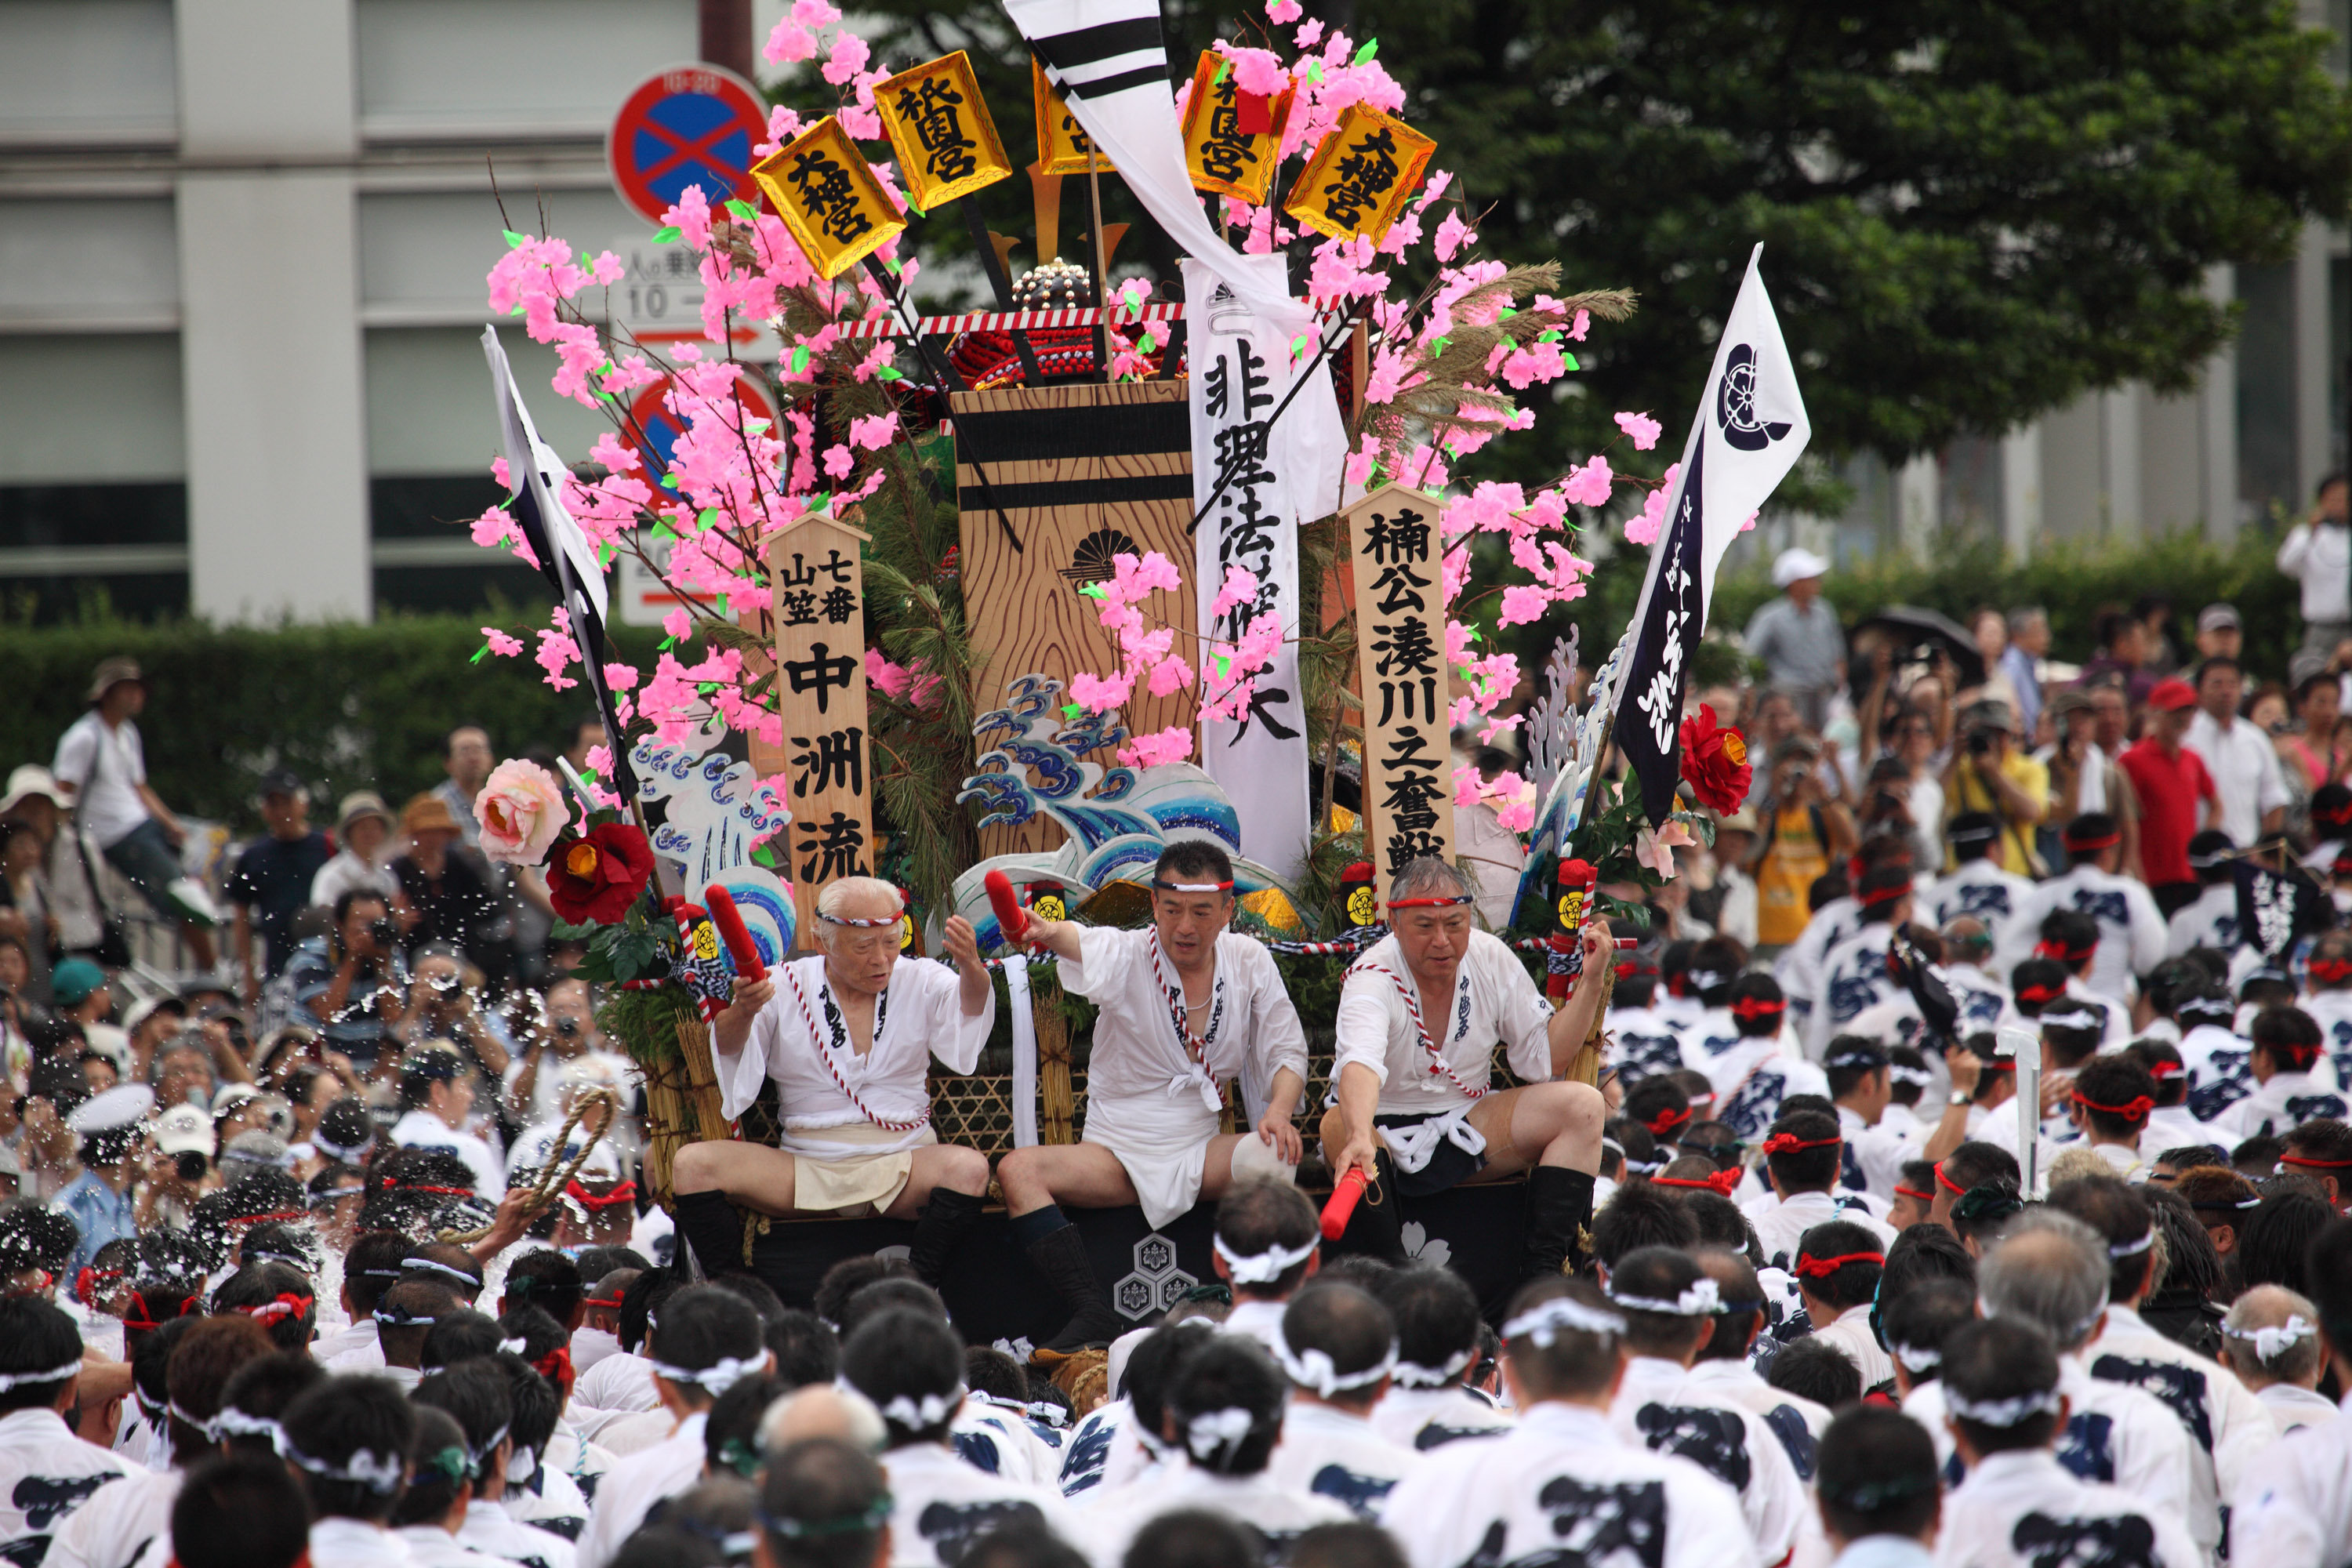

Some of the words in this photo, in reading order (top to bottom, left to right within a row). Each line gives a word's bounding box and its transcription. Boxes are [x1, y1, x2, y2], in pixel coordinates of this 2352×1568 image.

[788, 150, 872, 244] 大神宮
[1323, 128, 1399, 230] 大神宮
[780, 553, 818, 627] 山笠
[818, 549, 859, 626] 七番
[1361, 508, 1447, 877] 楠公湊川之奮戦
[783, 641, 869, 885] 中洲流
